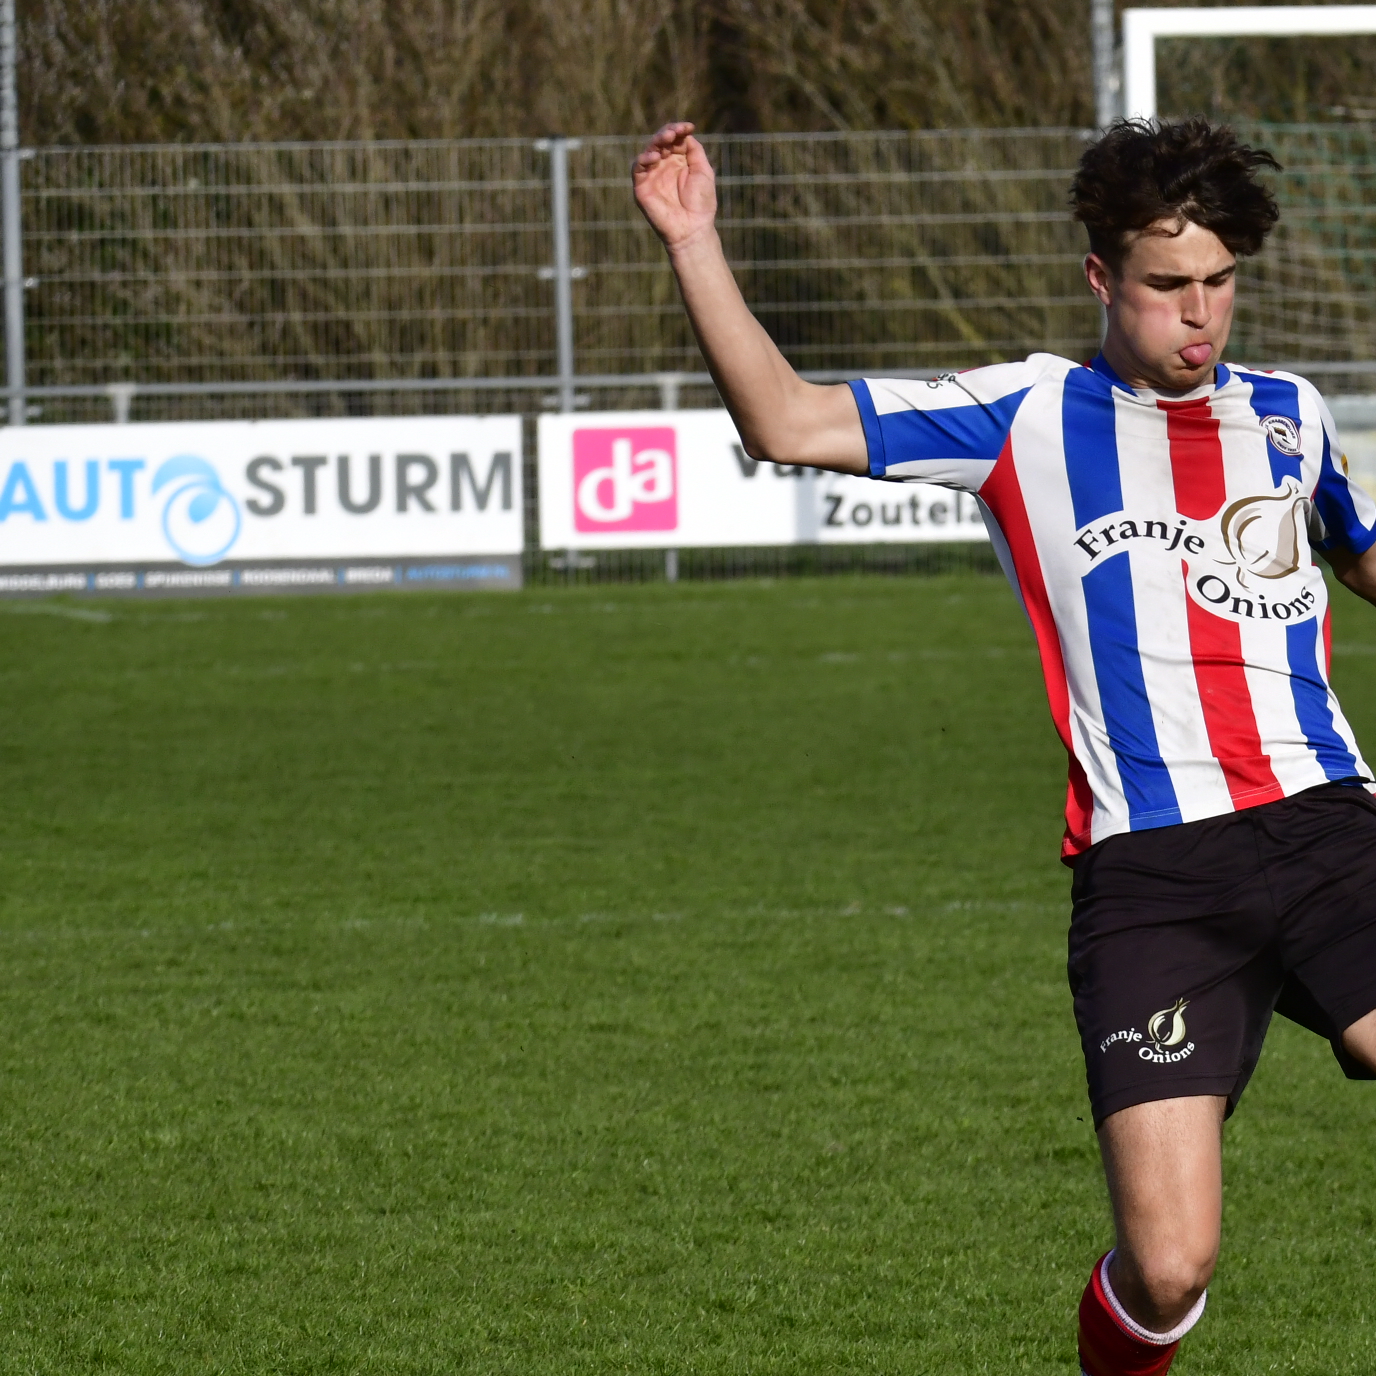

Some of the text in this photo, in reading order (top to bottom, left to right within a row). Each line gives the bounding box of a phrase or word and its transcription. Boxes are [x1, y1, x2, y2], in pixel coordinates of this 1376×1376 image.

[244, 450, 514, 518] STURM
[823, 493, 985, 527] Zoutela
[1073, 518, 1205, 561] Franje
[1196, 574, 1316, 620] Onions
[1100, 1027, 1143, 1054] Franje
[1138, 1041, 1195, 1063] Onions
